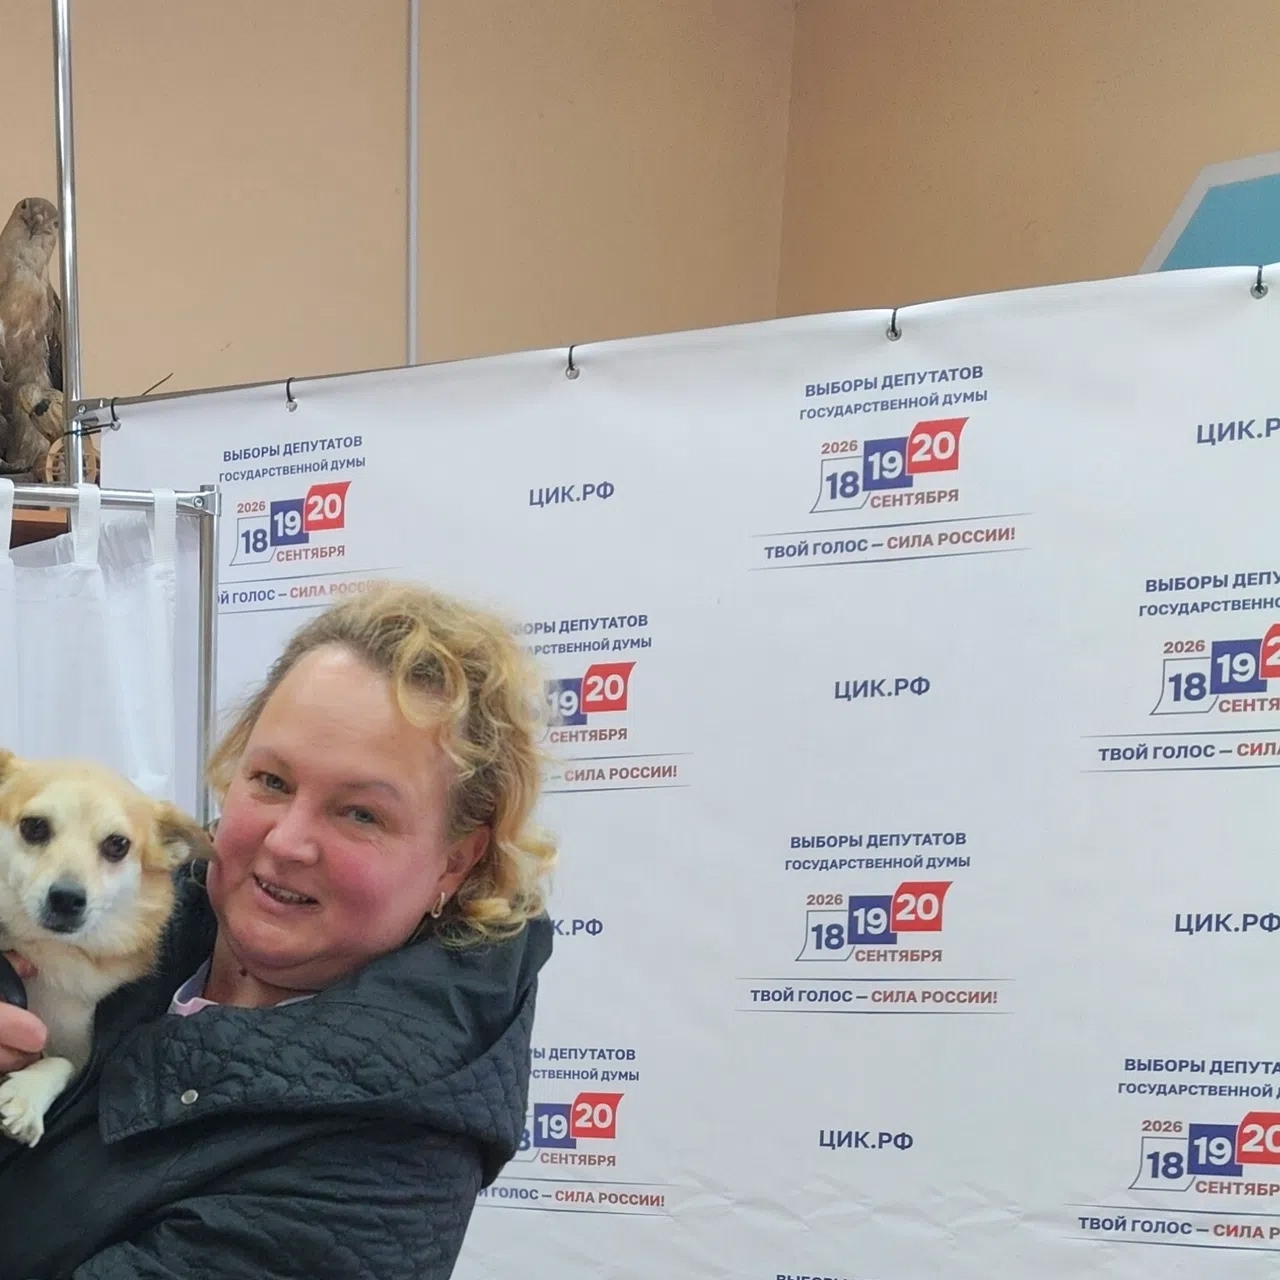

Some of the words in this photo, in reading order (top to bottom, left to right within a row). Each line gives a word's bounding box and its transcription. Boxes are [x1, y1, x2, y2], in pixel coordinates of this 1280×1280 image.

[806, 377, 877, 397] ВЫБОРЫ
[881, 366, 983, 390] ДЕПУТАТОВ
[800, 393, 939, 420] ГОСУДАРСТВЕННОЙ
[942, 390, 987, 406] ДУМЫ
[224, 445, 279, 462] ВЫБОРЫ
[283, 436, 362, 456] ДЕПУТАТОВ
[821, 440, 858, 454] 2026
[220, 459, 328, 482] ГОСУДАРСТВЕННОЙ
[331, 457, 365, 471] ДУМЫ
[826, 471, 859, 499] 18
[868, 449, 902, 480] 19
[912, 430, 955, 462] 20
[530, 481, 614, 508] ЦИК.РФ
[871, 489, 959, 508] СЕНТЯБРЯ
[237, 501, 265, 513] 2026
[241, 529, 267, 553] 18
[274, 511, 301, 537] 19
[308, 494, 341, 521] 20
[764, 541, 808, 559] ТВОЙ
[813, 539, 867, 555] ГОЛОС
[887, 534, 934, 549] СИЛА
[938, 527, 1015, 545] РОССИИ!
[277, 545, 345, 562] СЕНТЯБРЯ
[1146, 575, 1228, 592] ВЫБОРЫ
[233, 590, 275, 603] ГОЛОС
[290, 585, 326, 598] СИЛА
[559, 615, 648, 634] ДЕПУТАТОВ
[612, 637, 651, 651] ДУМЫ
[1164, 640, 1205, 654] 2026
[1169, 673, 1206, 701] 18
[1217, 653, 1256, 683] 19
[586, 674, 624, 702] 20
[835, 677, 930, 701] ЦИК.РФ
[550, 728, 627, 743] СЕНТЯБРЯ
[1098, 744, 1148, 761] ТВОЙ
[1153, 745, 1215, 759] ГОЛОС
[565, 769, 605, 781] СИЛА
[609, 765, 677, 779] РОССИИ!
[791, 835, 862, 848] ВЫБОРЫ
[866, 833, 966, 849] ДЕПУТАТОВ
[785, 855, 923, 871] ГОСУДАРСТВЕННОЙ
[926, 857, 970, 869] ДУМЫ
[807, 894, 843, 905] 2026
[812, 924, 844, 949] 18
[853, 908, 887, 934] 19
[896, 894, 939, 920] 20
[1175, 913, 1280, 935] ЦИК.РФ
[855, 950, 942, 962] СЕНТЯБРЯ
[751, 987, 794, 1001] ТВОЙ
[799, 990, 852, 1002] ГОЛОС
[872, 991, 917, 1002] СИЛА
[922, 991, 997, 1003] РОССИИ!
[549, 1048, 635, 1060] ДЕПУТАТОВ
[1125, 1059, 1205, 1072] ВЫБОРЫ
[601, 1071, 639, 1081] ДУМЫ
[1118, 1083, 1272, 1097] ГОСУДАРСТВЕННОЙ
[538, 1114, 567, 1139] 19
[575, 1103, 612, 1128] 20
[1142, 1120, 1182, 1132] 2026
[820, 1130, 913, 1150] ЦИК.РФ
[541, 1153, 615, 1166] СЕНТЯБРЯ
[1147, 1152, 1183, 1179] 18
[1194, 1137, 1232, 1166] 19
[492, 1187, 538, 1200] ГОЛОС
[555, 1191, 595, 1203] СИЛА
[599, 1193, 664, 1207] РОССИИ!
[1078, 1216, 1126, 1231] ТВОЙ
[1131, 1220, 1192, 1234] ГОЛОС
[1214, 1224, 1264, 1238] СИЛА
